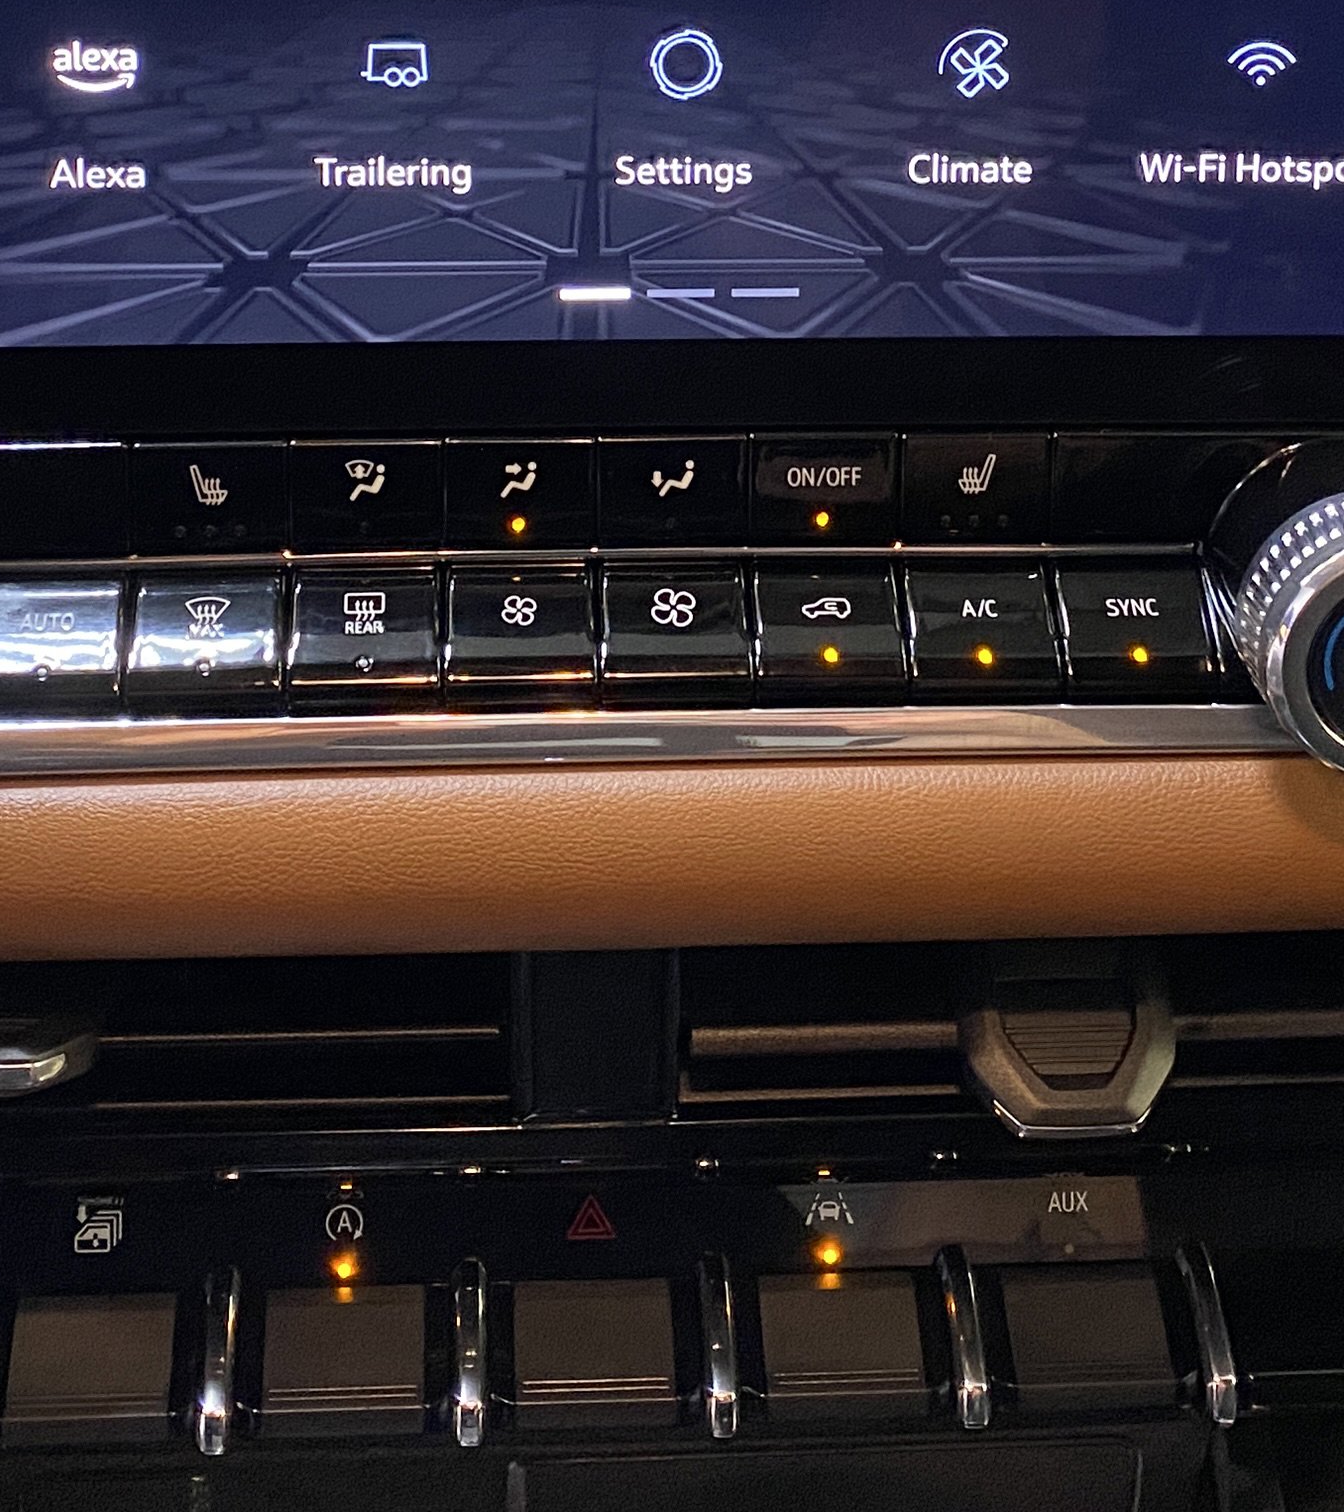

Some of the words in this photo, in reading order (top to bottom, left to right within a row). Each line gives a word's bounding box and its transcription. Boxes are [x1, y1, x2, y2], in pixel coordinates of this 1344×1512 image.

[53, 41, 137, 74] alexa
[50, 157, 145, 188] Alexa
[314, 155, 471, 194] Trailering
[616, 156, 752, 193] Settings
[909, 153, 1032, 184] Climate
[1140, 151, 1226, 182] Wi-Fi
[788, 467, 861, 486] ON/OFF
[963, 599, 998, 617] A/C
[1106, 599, 1159, 616] SYNC
[19, 611, 75, 632] AUTO
[344, 619, 385, 635] REAR
[1048, 1192, 1088, 1212] AUX
